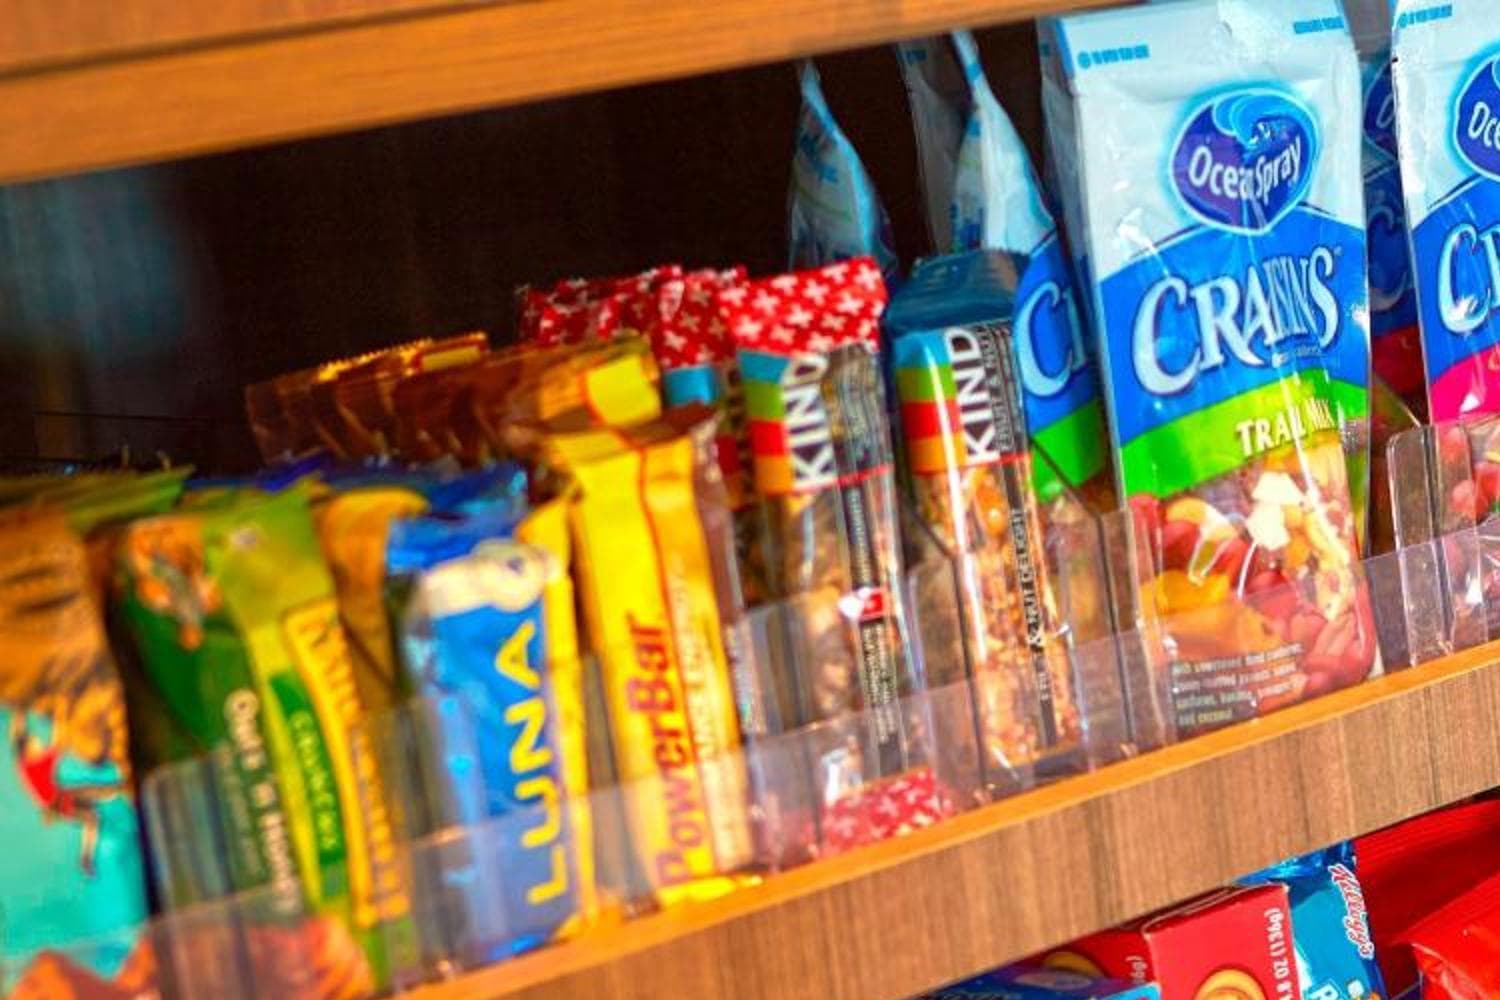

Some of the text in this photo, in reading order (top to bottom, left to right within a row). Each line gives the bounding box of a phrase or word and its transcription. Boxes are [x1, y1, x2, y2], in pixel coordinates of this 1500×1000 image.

[1254, 137, 1302, 206] Spray
[944, 326, 1000, 466] KIND
[495, 620, 568, 905] LUNA
[625, 612, 702, 887] PowerBar
[1328, 861, 1376, 961] Kellogg's
